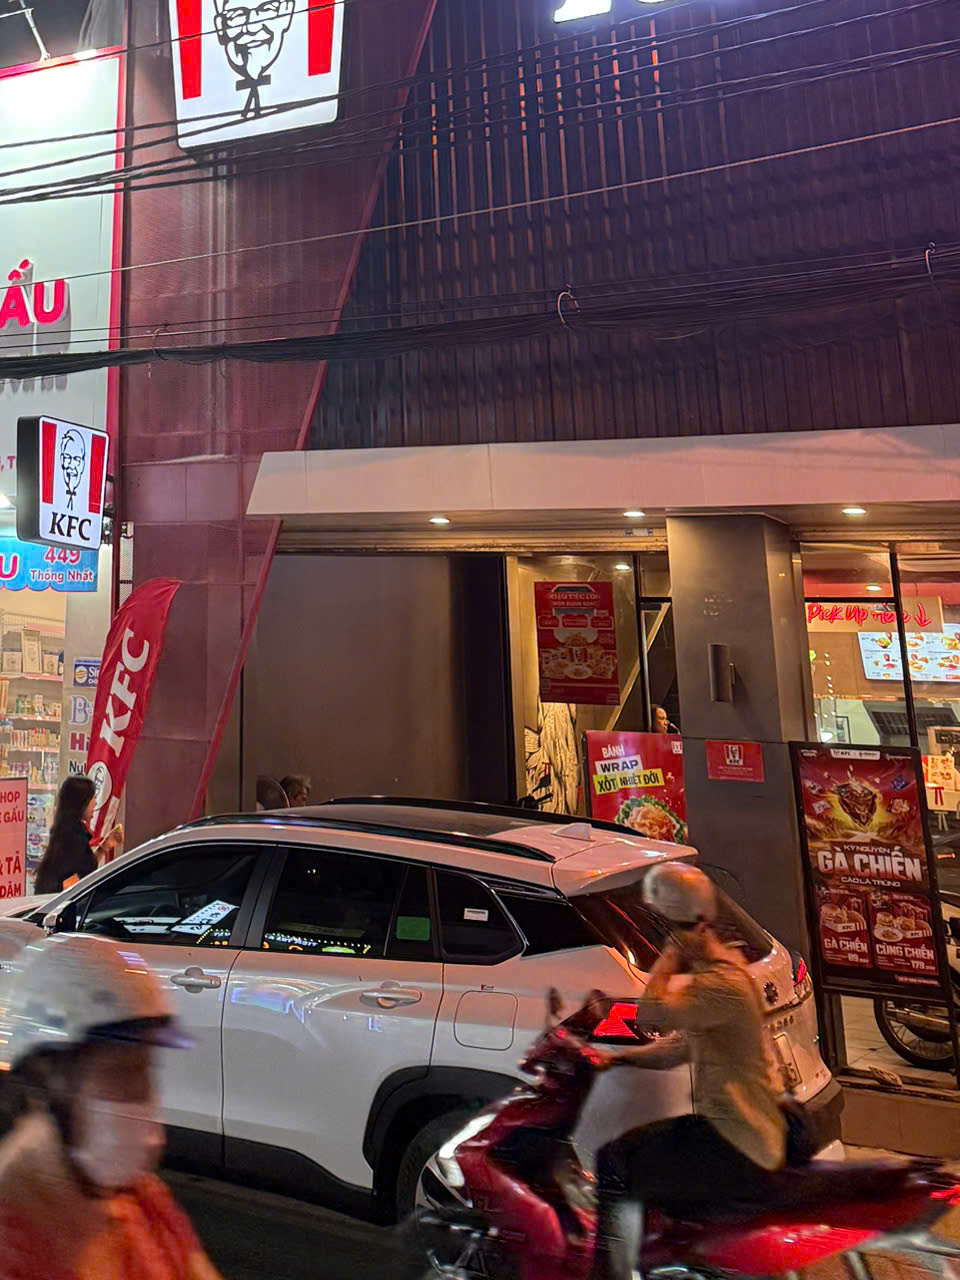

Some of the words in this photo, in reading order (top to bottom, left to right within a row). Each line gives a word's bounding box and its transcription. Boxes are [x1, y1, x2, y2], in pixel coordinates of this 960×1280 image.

[49, 511, 92, 541] KFC
[45, 546, 81, 565] 449
[30, 568, 65, 585] Thống
[67, 568, 94, 582] Nhất
[99, 627, 151, 758] KFC
[601, 744, 625, 758] BÁNH
[600, 759, 639, 774] WRAP
[643, 770, 660, 785] ĐỚI
[3, 806, 25, 824] GẤU
[817, 846, 849, 874] GÀ
[853, 845, 922, 882] CHIẾN
[824, 937, 838, 950] GÀ
[840, 938, 868, 953] CHIẾN
[876, 942, 903, 957] CÙNG
[905, 944, 935, 961] CHIẾN
